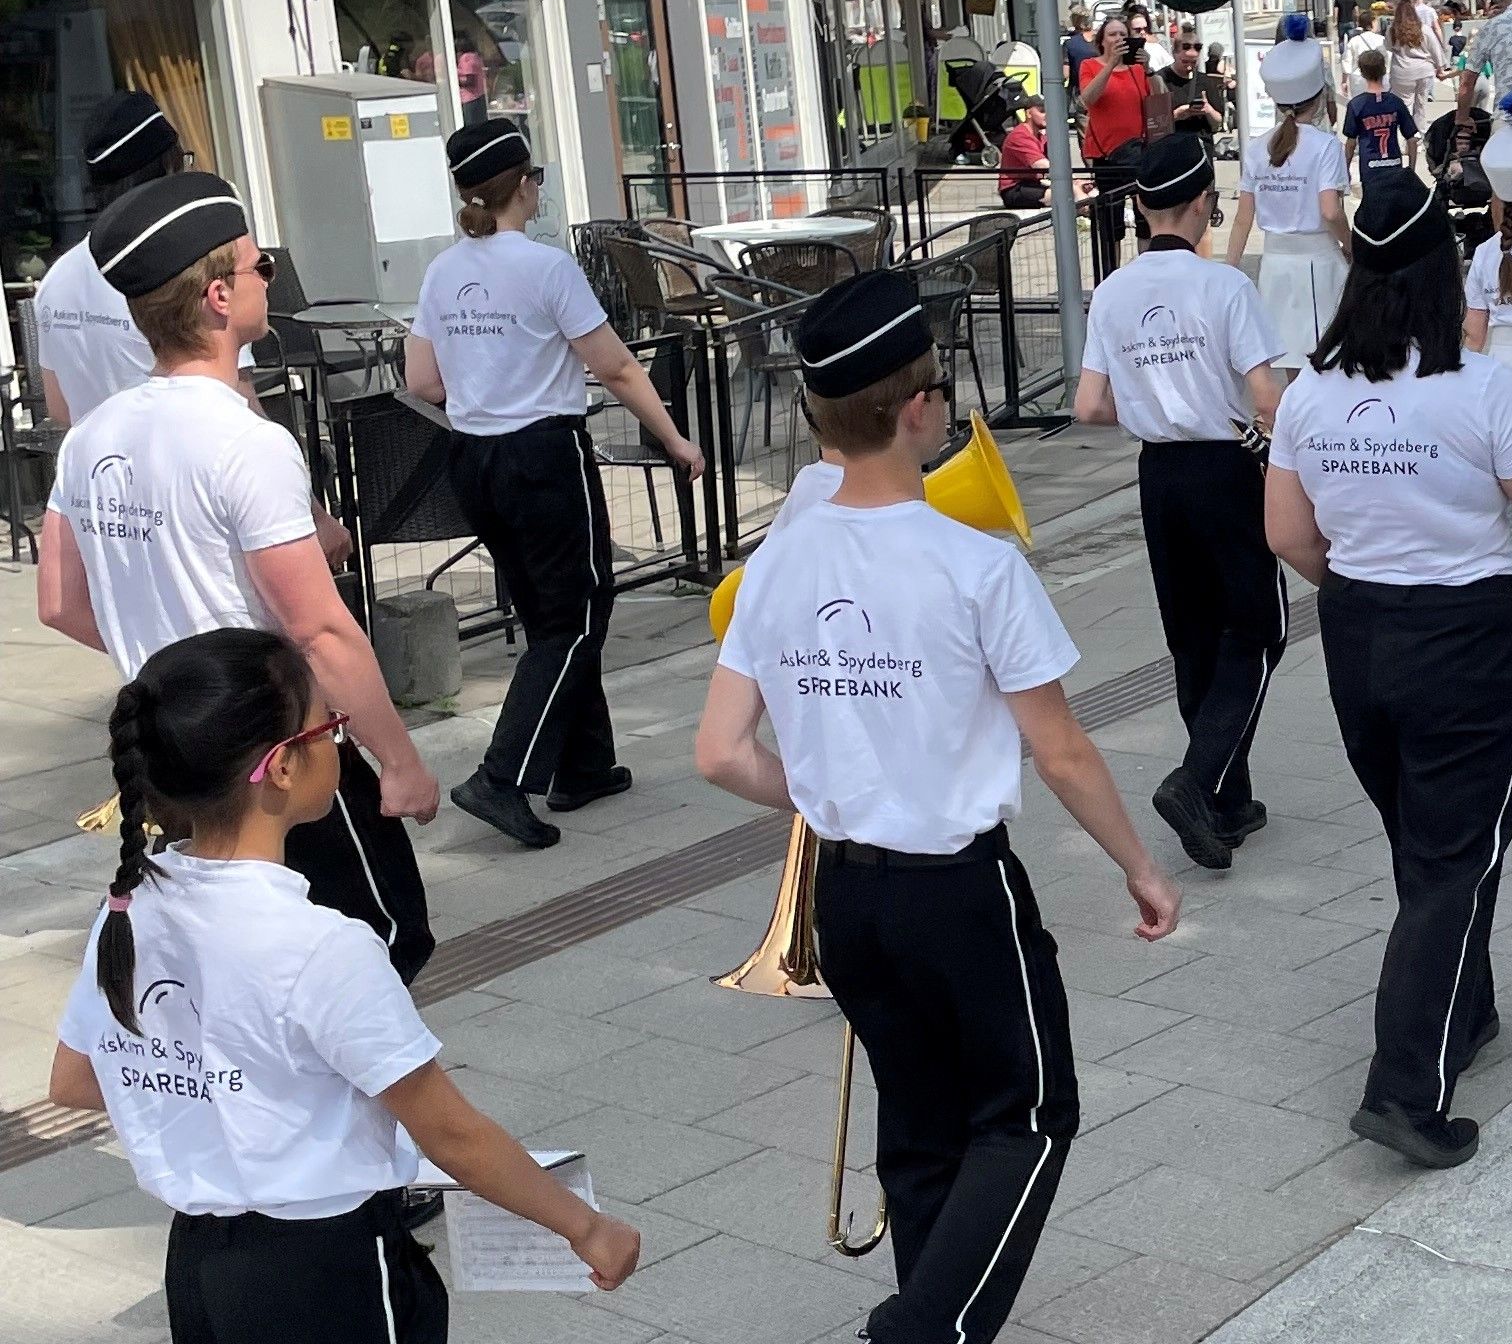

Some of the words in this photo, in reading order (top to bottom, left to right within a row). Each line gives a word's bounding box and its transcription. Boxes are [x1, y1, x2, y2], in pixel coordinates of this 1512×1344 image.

[1374, 128, 1390, 159] 7
[1148, 337, 1157, 348] &
[1307, 437, 1346, 453] Askim
[1350, 437, 1360, 452] &
[1364, 437, 1439, 459] Spydeberg
[1322, 459, 1420, 476] SPAREBANK
[817, 649, 831, 667] &
[838, 649, 923, 678] Spydeberg
[151, 1037, 168, 1059] &
